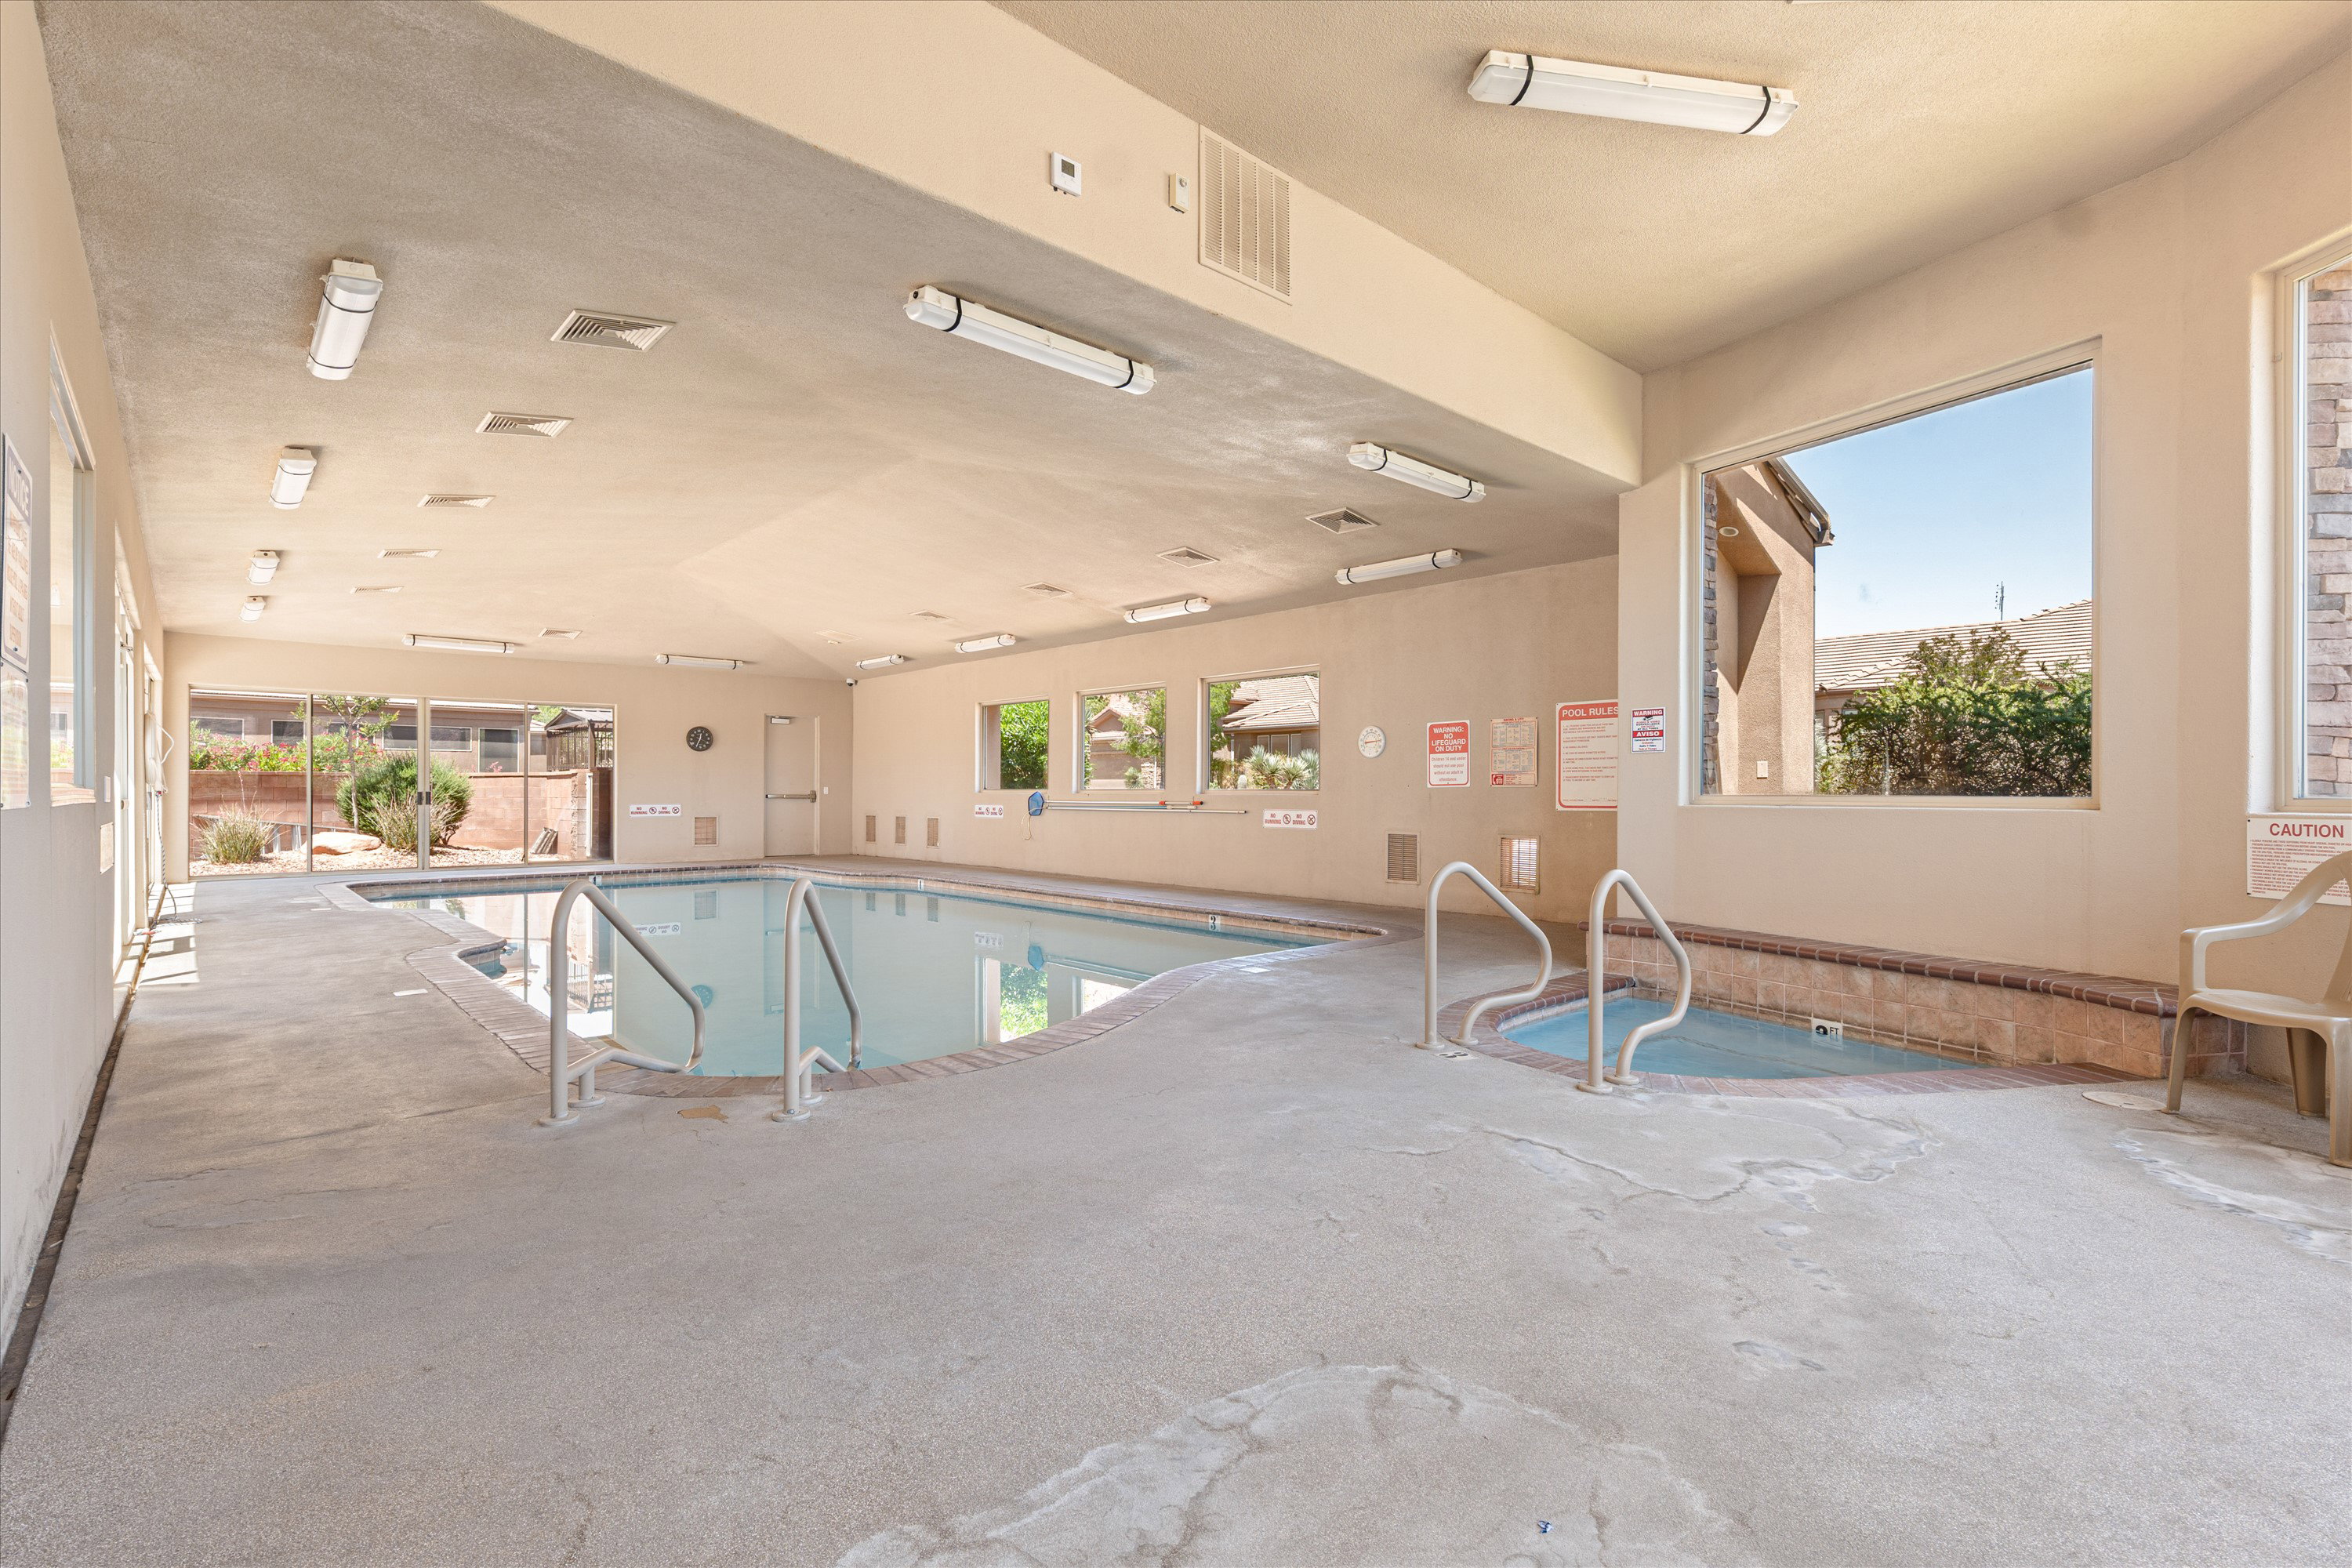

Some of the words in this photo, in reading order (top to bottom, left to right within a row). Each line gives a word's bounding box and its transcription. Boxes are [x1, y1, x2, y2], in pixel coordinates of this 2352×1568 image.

[8, 457, 29, 517] NOTICE
[1562, 708, 1586, 717] POOL
[1589, 706, 1618, 716] RULES
[2269, 823, 2344, 838] CAUTION
